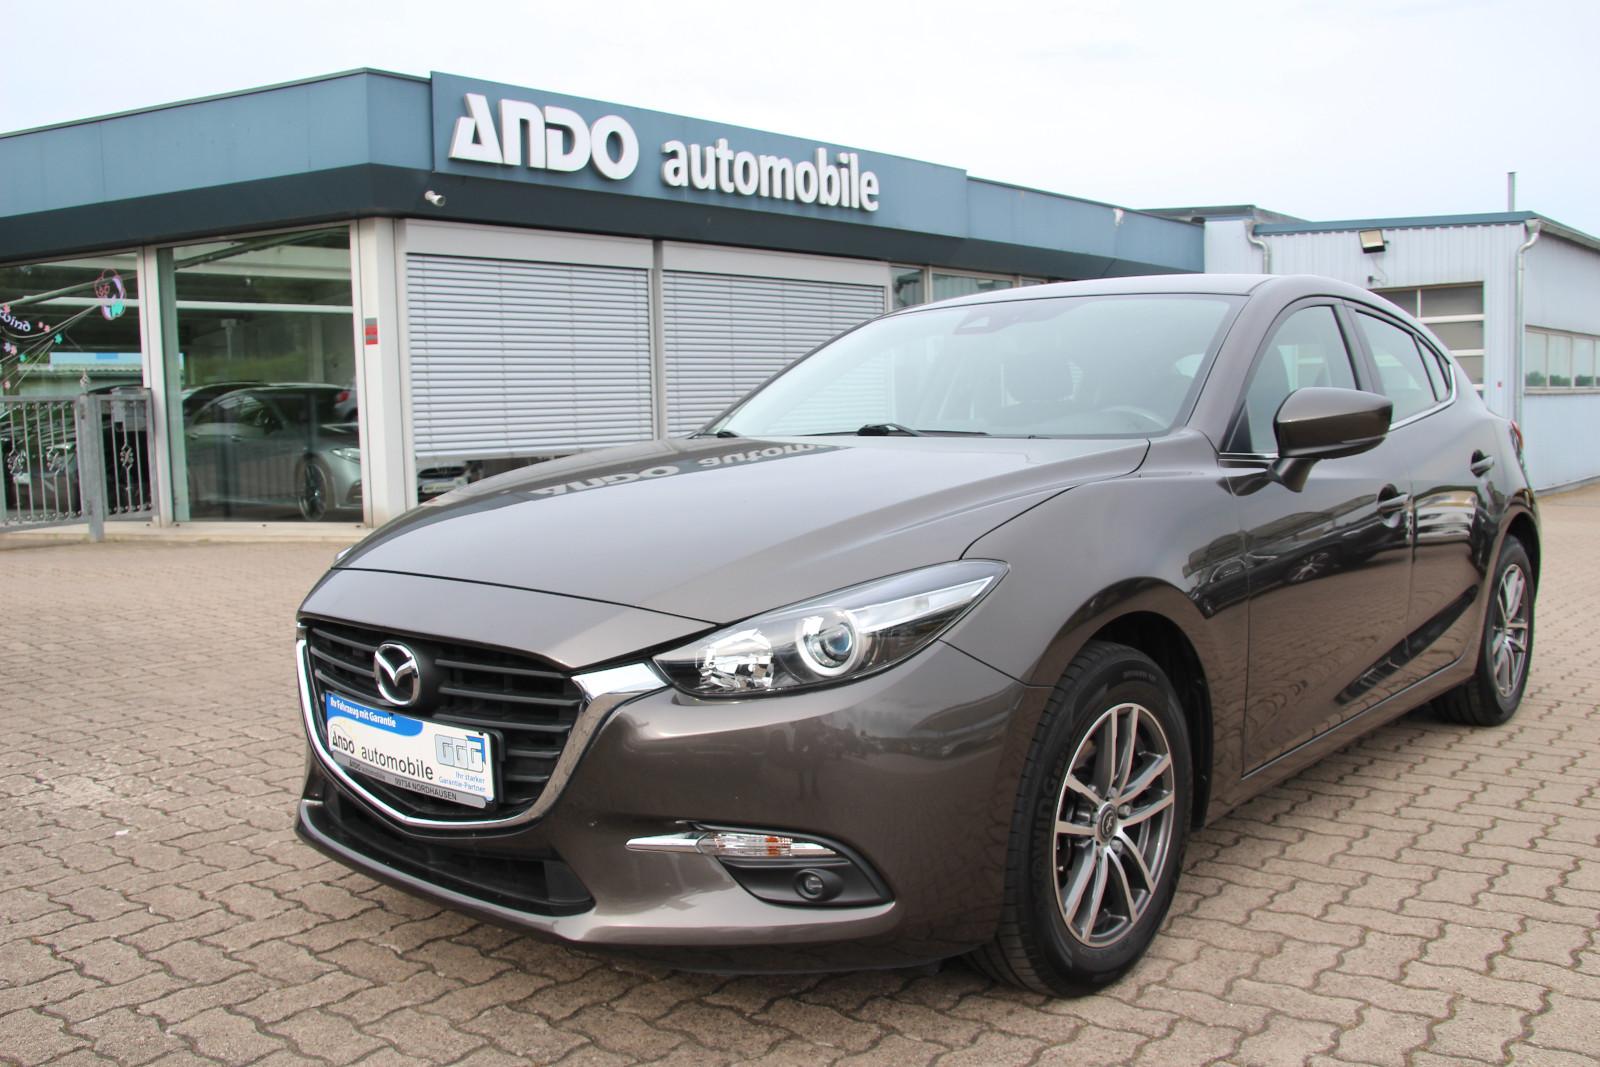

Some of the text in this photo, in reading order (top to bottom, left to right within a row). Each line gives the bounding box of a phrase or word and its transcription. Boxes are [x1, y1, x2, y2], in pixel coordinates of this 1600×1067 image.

[448, 93, 879, 212] ANDO automobile
[337, 699, 359, 719] Fahrzeug
[360, 709, 369, 720] mit
[369, 711, 397, 728] Garantie
[361, 746, 434, 780] automobile
[412, 782, 457, 801] NORDHAUSEN
